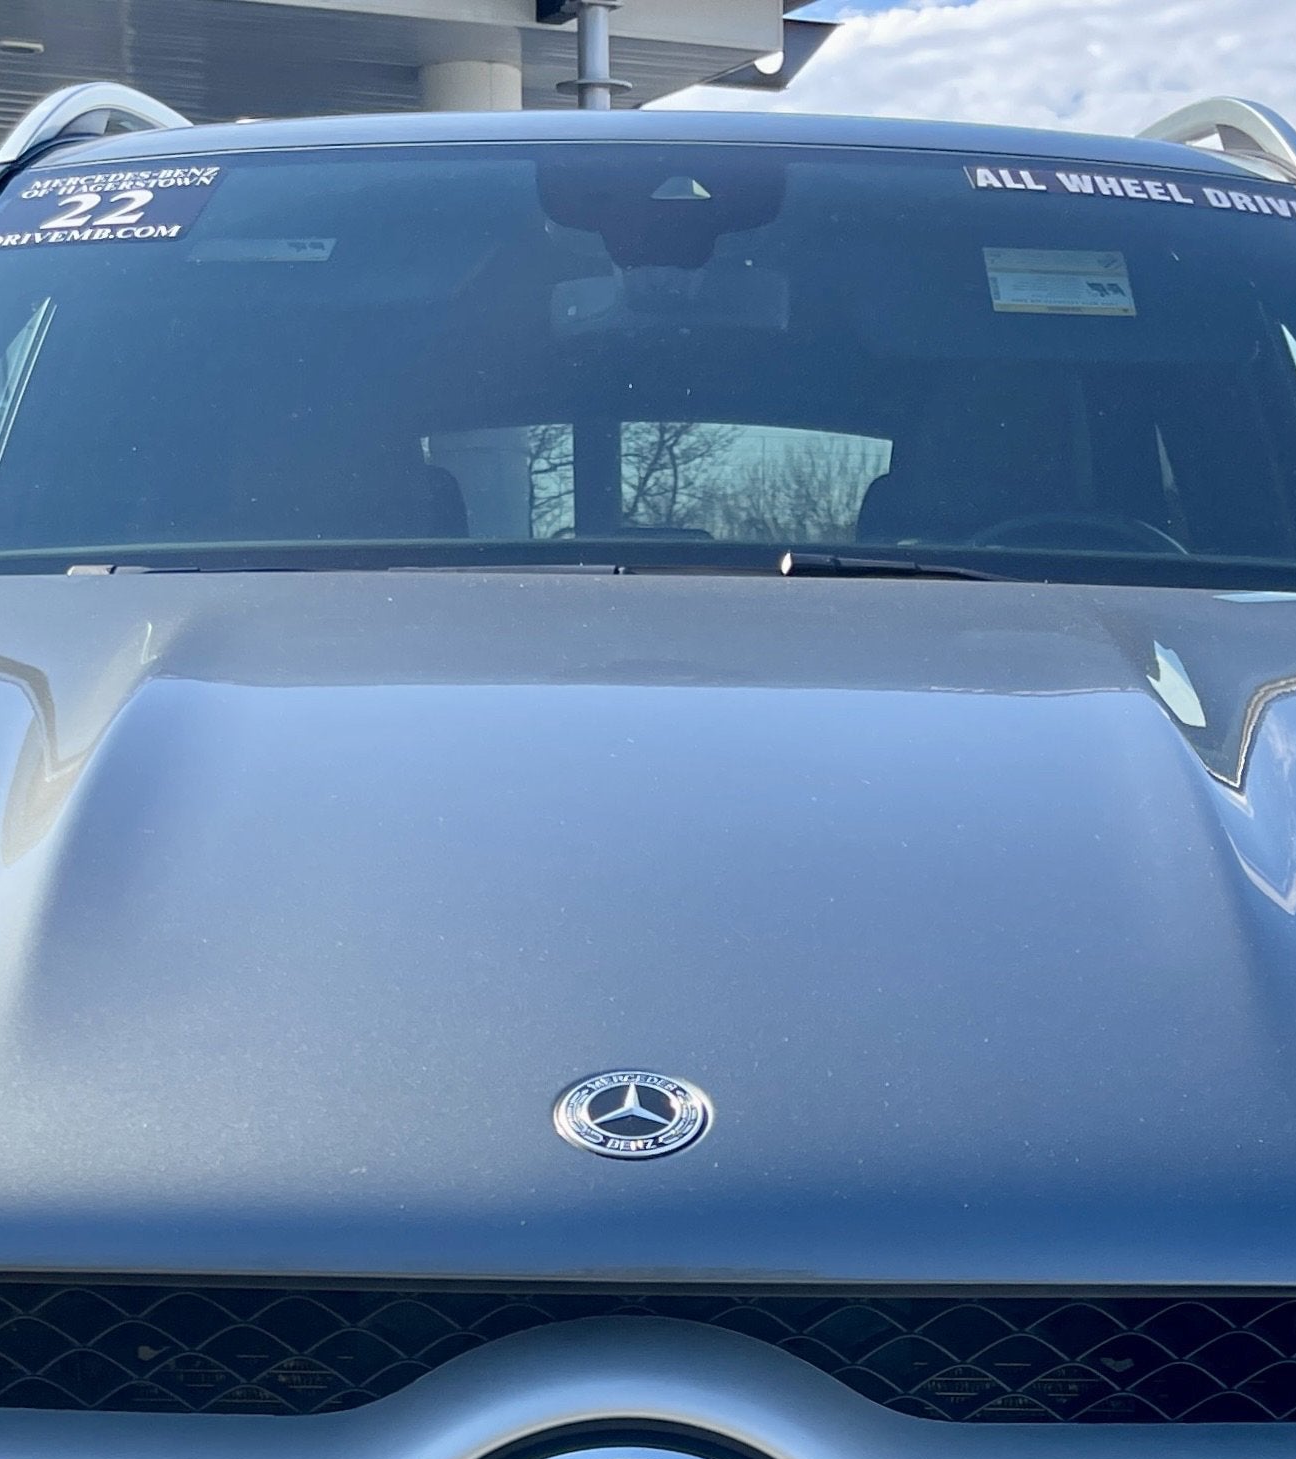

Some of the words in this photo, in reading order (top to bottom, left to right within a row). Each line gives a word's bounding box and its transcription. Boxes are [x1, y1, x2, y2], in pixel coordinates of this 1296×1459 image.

[20, 187, 51, 199] OF
[57, 176, 215, 197] HAGERSTOWN
[31, 167, 221, 190] MERCEDES-BENZ
[975, 167, 1048, 191] ALL
[1055, 171, 1195, 204] WHEEL
[39, 189, 154, 230] 22
